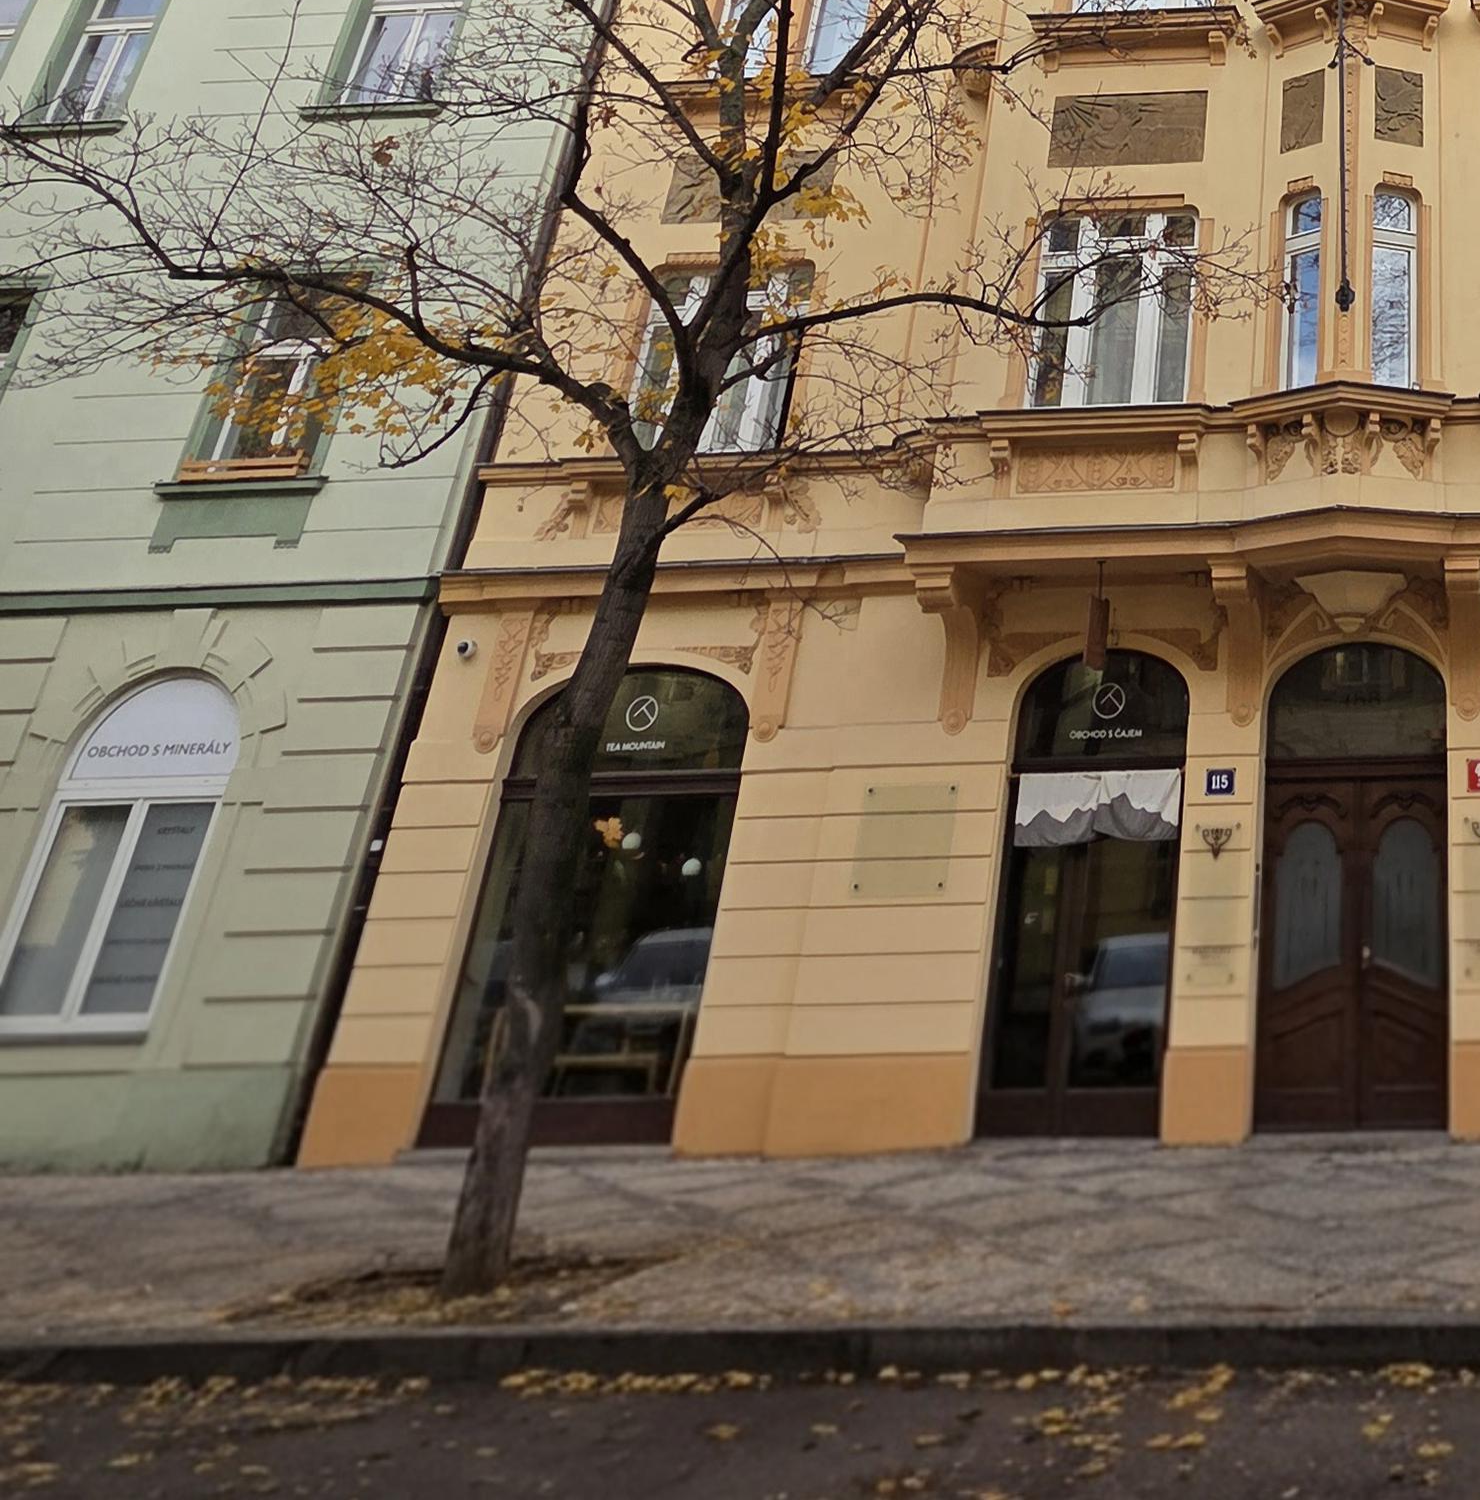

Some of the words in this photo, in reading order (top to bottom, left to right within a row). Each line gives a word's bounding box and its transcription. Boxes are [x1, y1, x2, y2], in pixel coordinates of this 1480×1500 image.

[1069, 729, 1107, 739] OBCHOD
[1114, 728, 1143, 738] ČAJEM
[87, 744, 150, 758] OBCHOD
[151, 744, 160, 757] S
[162, 739, 232, 756] MINERÁLY
[606, 742, 621, 752] TEA
[622, 740, 666, 751] MOUNTAIN
[1211, 774, 1229, 790] 115
